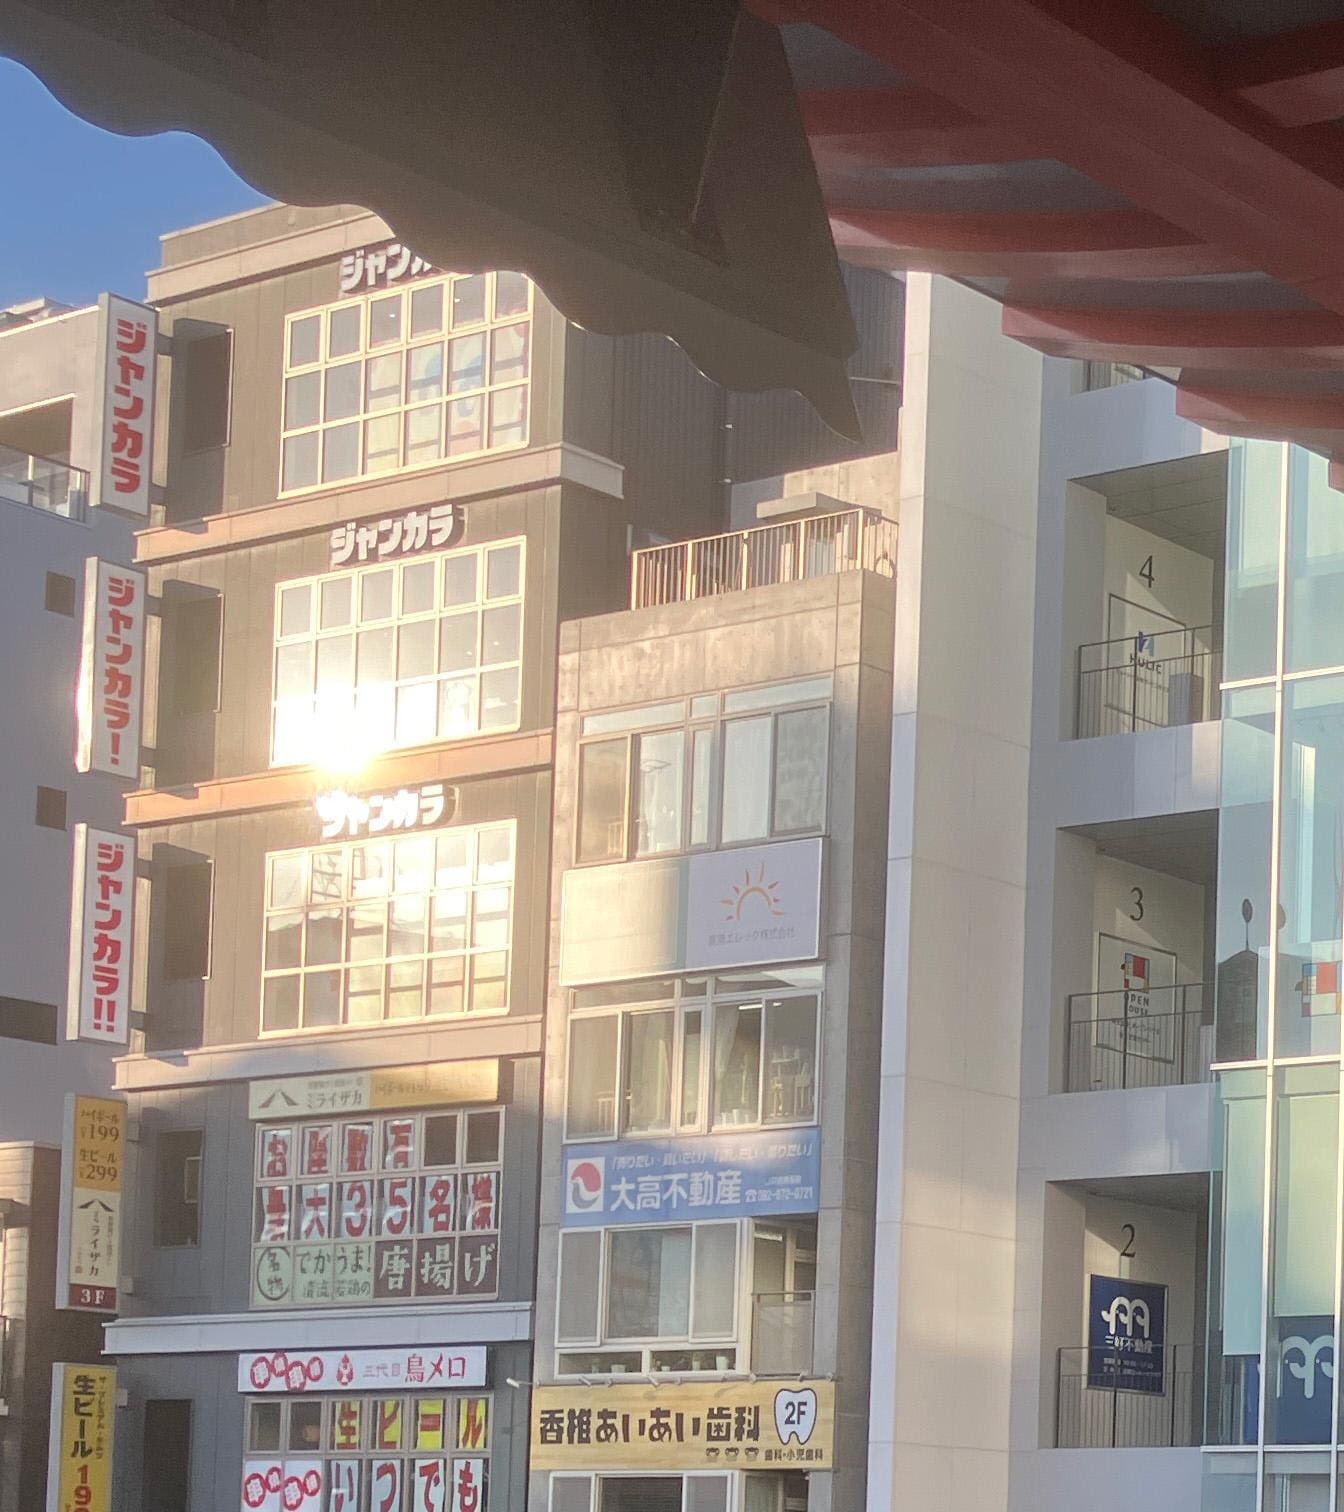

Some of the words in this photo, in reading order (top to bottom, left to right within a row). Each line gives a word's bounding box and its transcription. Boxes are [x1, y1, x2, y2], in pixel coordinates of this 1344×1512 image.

[111, 319, 148, 494] ジャンカラ
[331, 504, 456, 565] ジャンカラ
[1139, 555, 1155, 588] 4
[103, 577, 135, 764] ジャンカラ!
[1130, 653, 1162, 675] HULIC
[1129, 887, 1144, 921] 3
[610, 1170, 742, 1212] 大高不動産
[1121, 1223, 1136, 1257] 2
[379, 1243, 496, 1291] 唐揚げ
[404, 1353, 467, 1383] 鳥メロ
[70, 1375, 97, 1459] 生ビール
[335, 1399, 483, 1450] 生ビール
[540, 1405, 760, 1445] 香椎あいあい歯科
[784, 1401, 808, 1425] 2F
